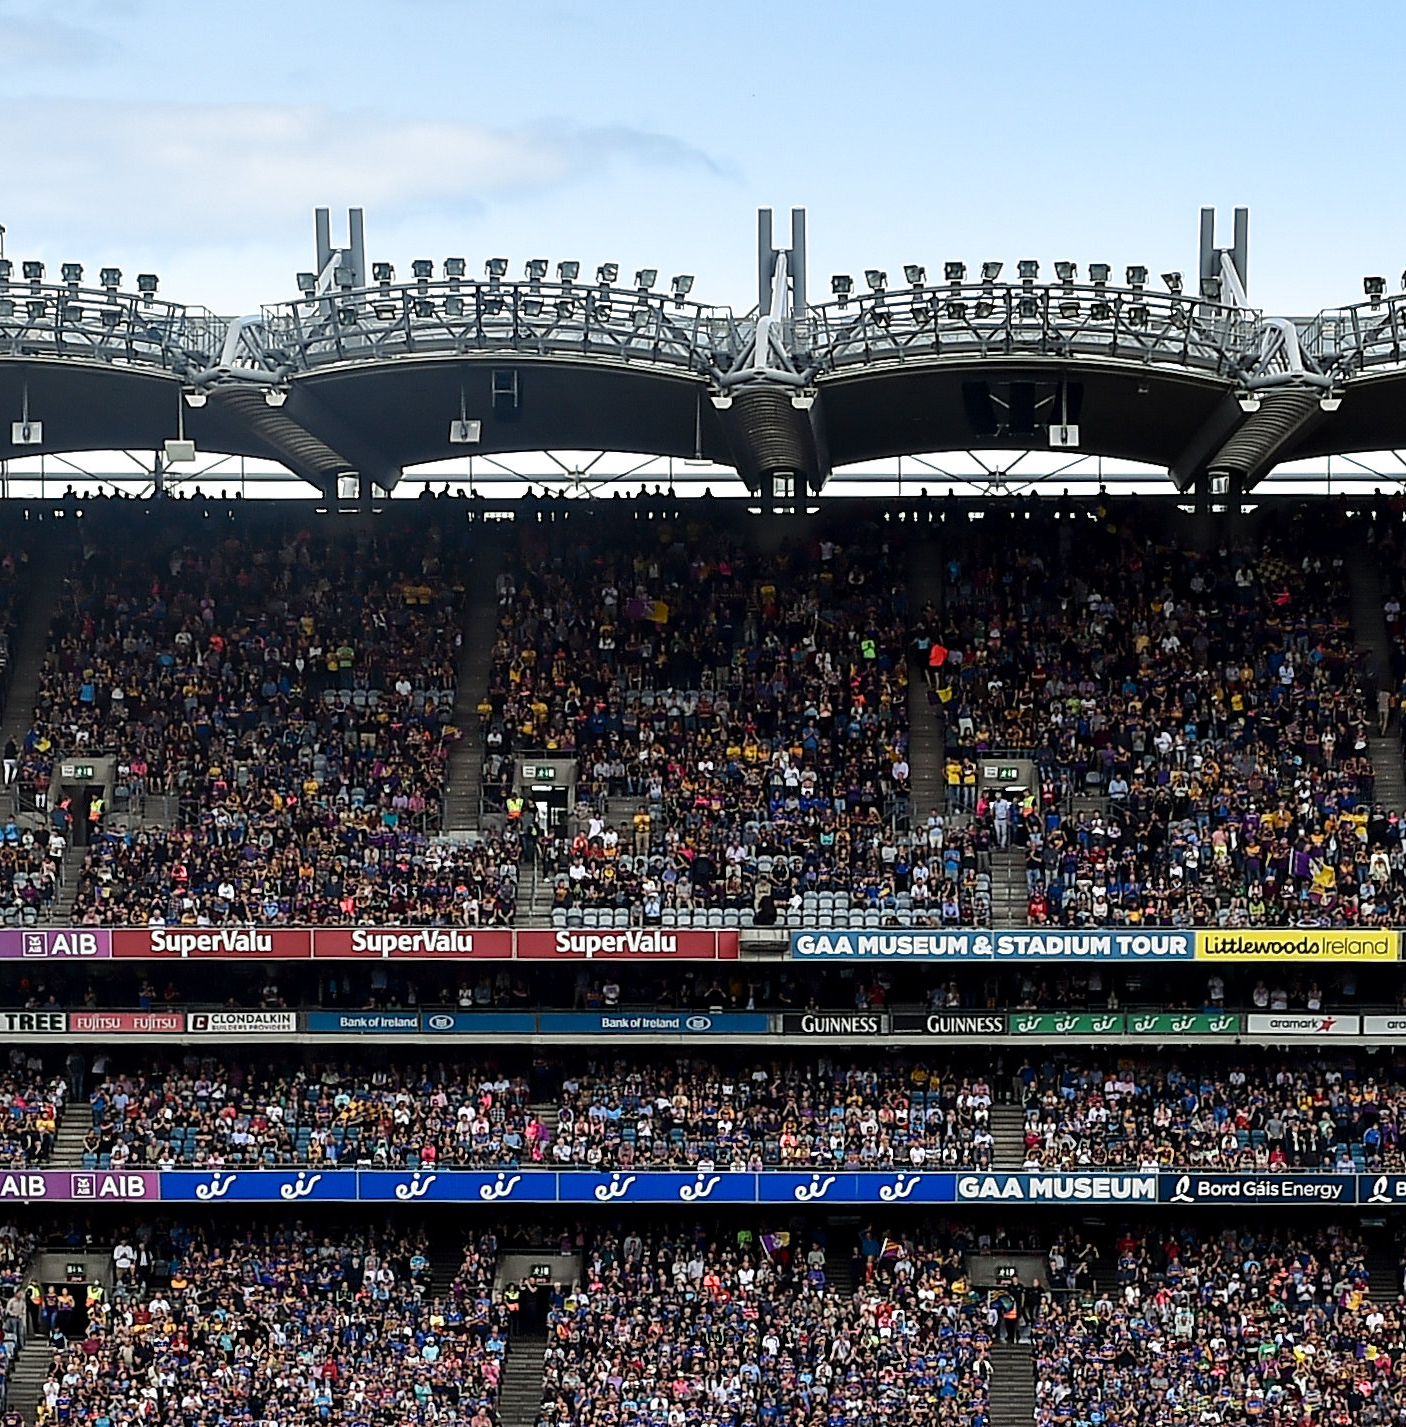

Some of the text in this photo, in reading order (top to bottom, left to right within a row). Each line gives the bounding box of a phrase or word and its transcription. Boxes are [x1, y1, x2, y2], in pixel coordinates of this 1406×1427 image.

[52, 934, 96, 954] AIB
[151, 930, 272, 954] SuperValu
[352, 930, 474, 956] SuperValu
[556, 931, 677, 956] SuperValu
[798, 936, 1186, 954] GAA MUSEUM & STADIUM TOUR
[5, 1014, 62, 1031] TREE
[77, 1015, 121, 1029] FUJITSU
[134, 1015, 177, 1029] FUJITSU
[211, 1014, 290, 1025] CLONDALKIN
[341, 1018, 417, 1027] Bank of Ireland
[602, 1018, 679, 1028] Bank of Ireland
[802, 1015, 877, 1032] GUINNESS
[927, 1016, 1002, 1032] GUINNESS
[1271, 1019, 1317, 1028] aramark
[100, 1176, 144, 1196] AIB
[959, 1177, 1155, 1198] GAA MUSEUM
[1198, 1180, 1342, 1199] Bord Gáis Energy
